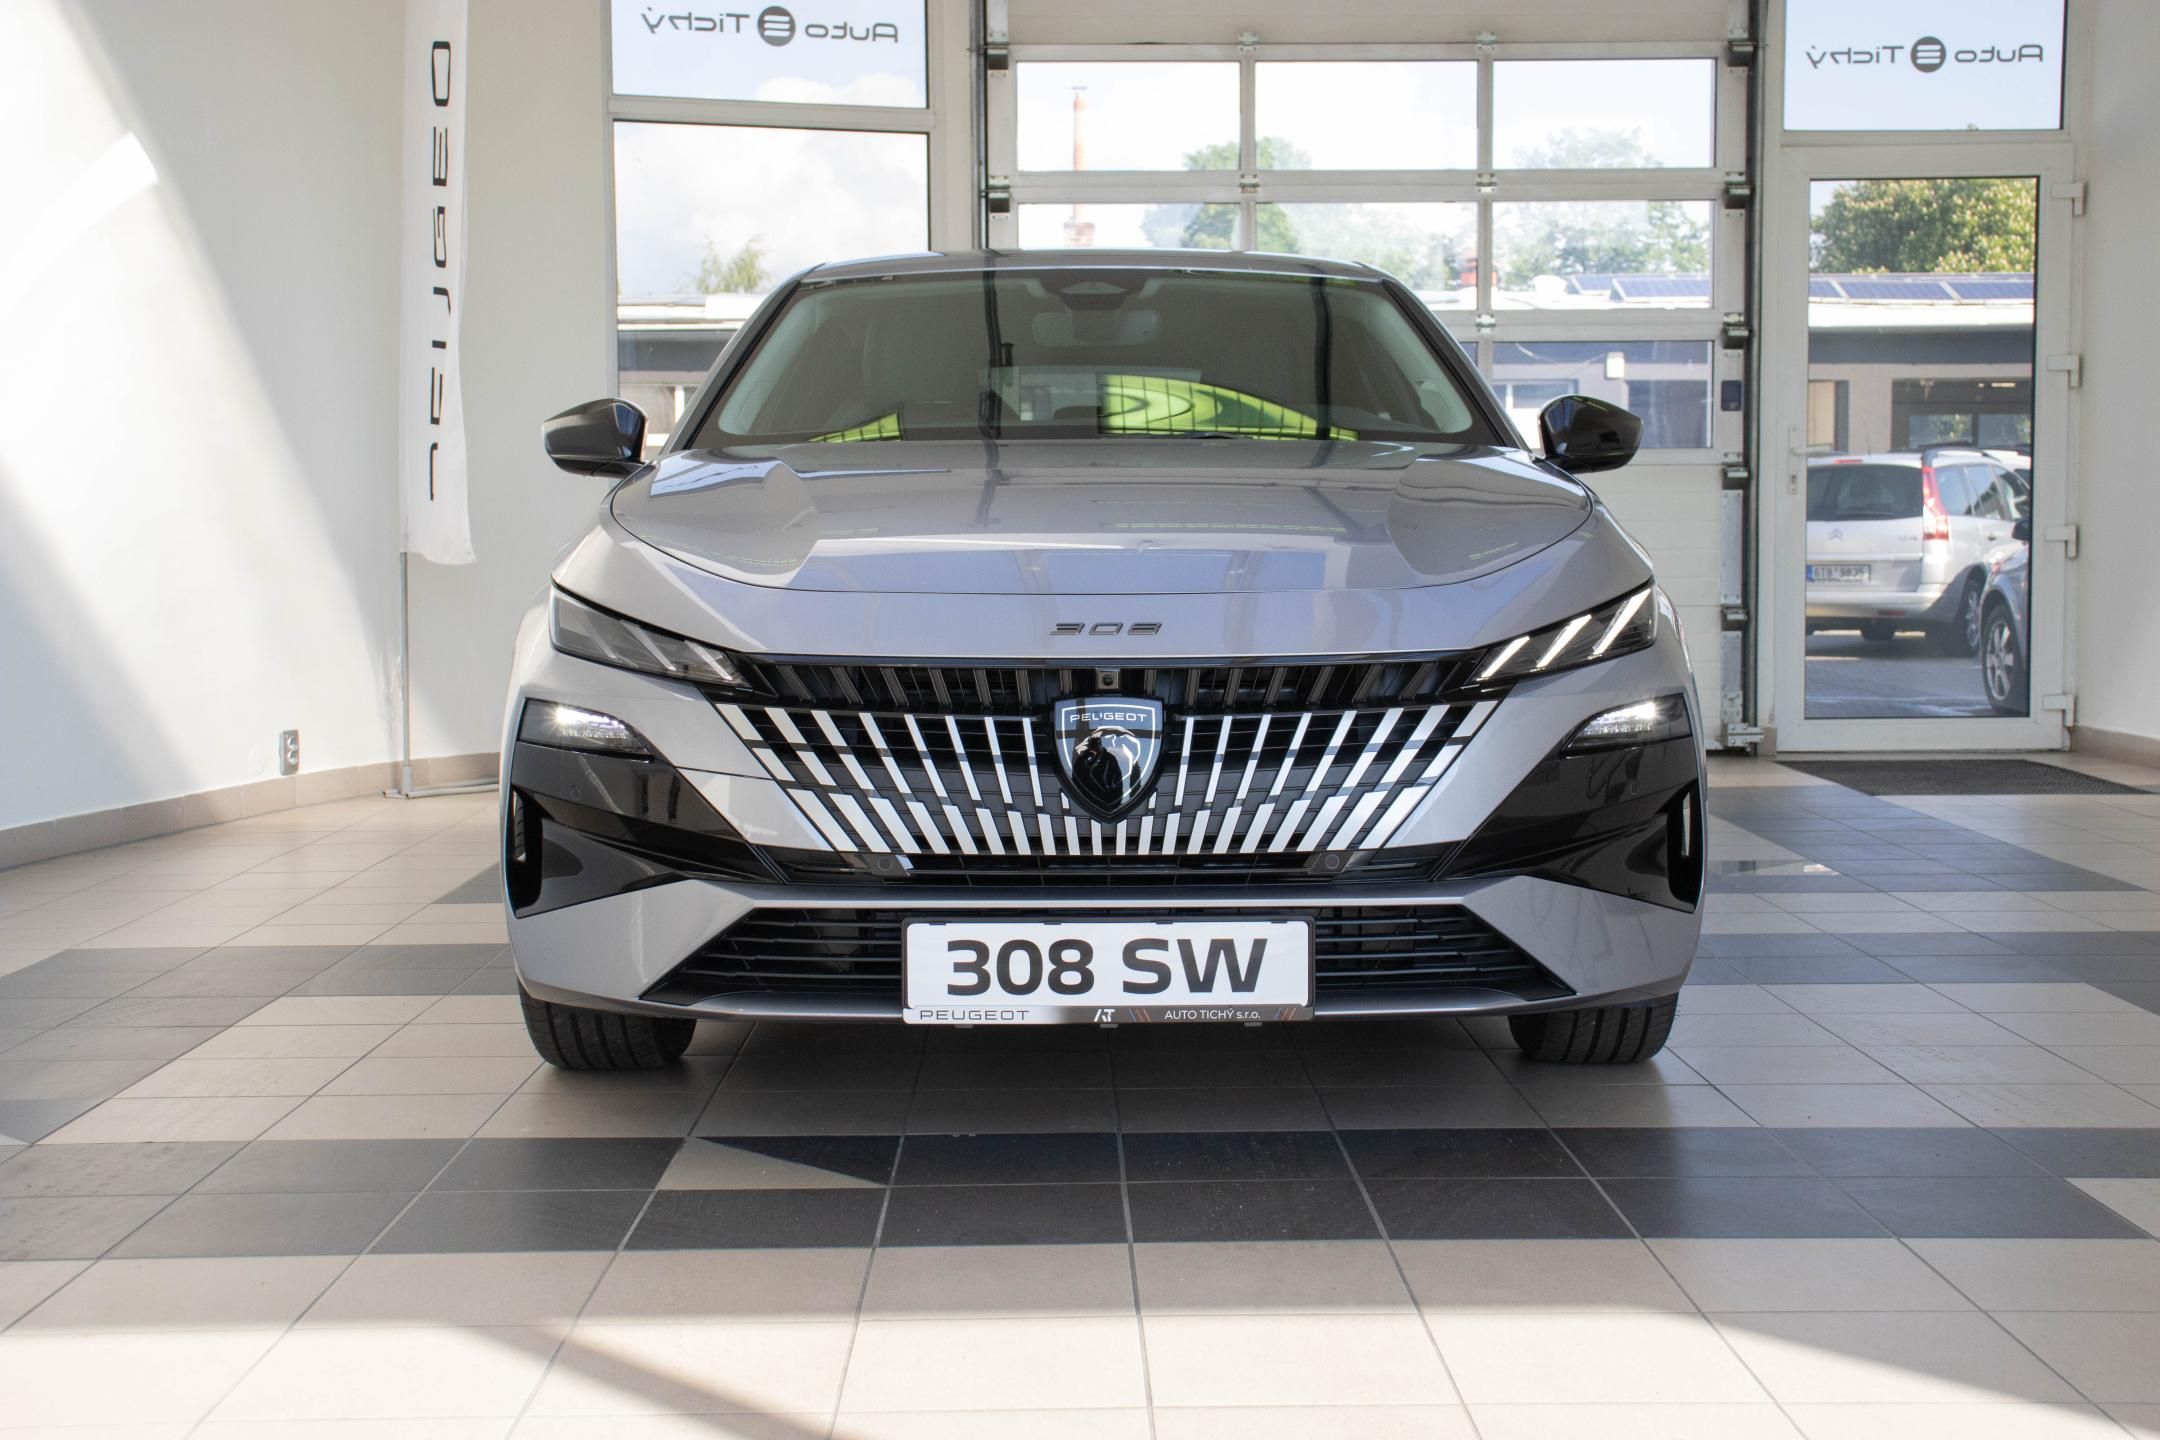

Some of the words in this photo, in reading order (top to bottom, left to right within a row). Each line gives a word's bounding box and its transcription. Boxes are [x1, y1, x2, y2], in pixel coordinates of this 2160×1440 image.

[1050, 622, 1163, 636] 308
[1070, 712, 1148, 723] PEUGEOT
[947, 938, 1095, 996] 308
[1122, 938, 1268, 995] SW
[919, 1009, 1030, 1021] PEUGEOT
[1164, 1010, 1197, 1020] AUTO
[1199, 1008, 1234, 1019] TICHÝ
[1236, 1011, 1261, 1019] s.r.o.
